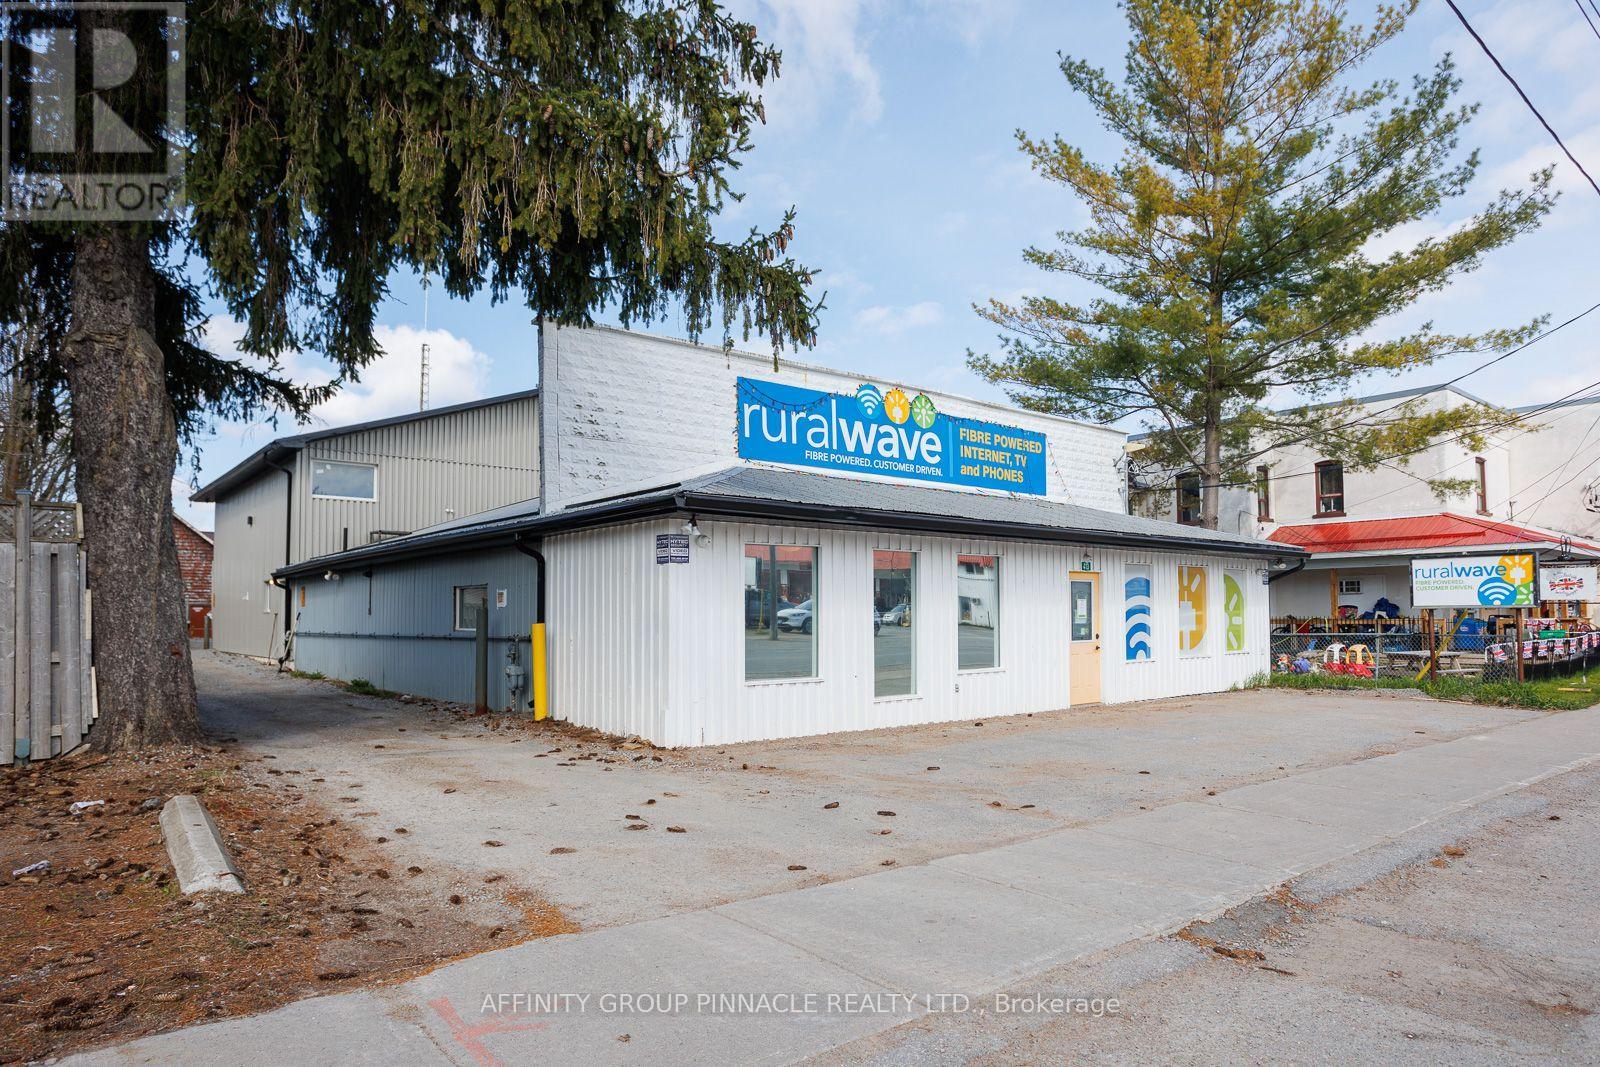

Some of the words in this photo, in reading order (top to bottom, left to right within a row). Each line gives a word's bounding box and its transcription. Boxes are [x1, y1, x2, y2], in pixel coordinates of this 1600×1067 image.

[743, 398, 942, 464] ruralwave
[959, 428, 991, 445] FIBRE
[994, 434, 1043, 454] POWERED
[805, 450, 829, 462] FIBRE
[830, 453, 873, 468] POWERED.
[873, 460, 915, 473] CUSTOMER
[915, 466, 943, 476] DRIVEN.
[960, 445, 1013, 467] INTERNET,
[1015, 454, 1027, 467] TV
[960, 464, 980, 476] and
[982, 465, 1024, 483] PHONES
[1414, 561, 1507, 579] ruralwave
